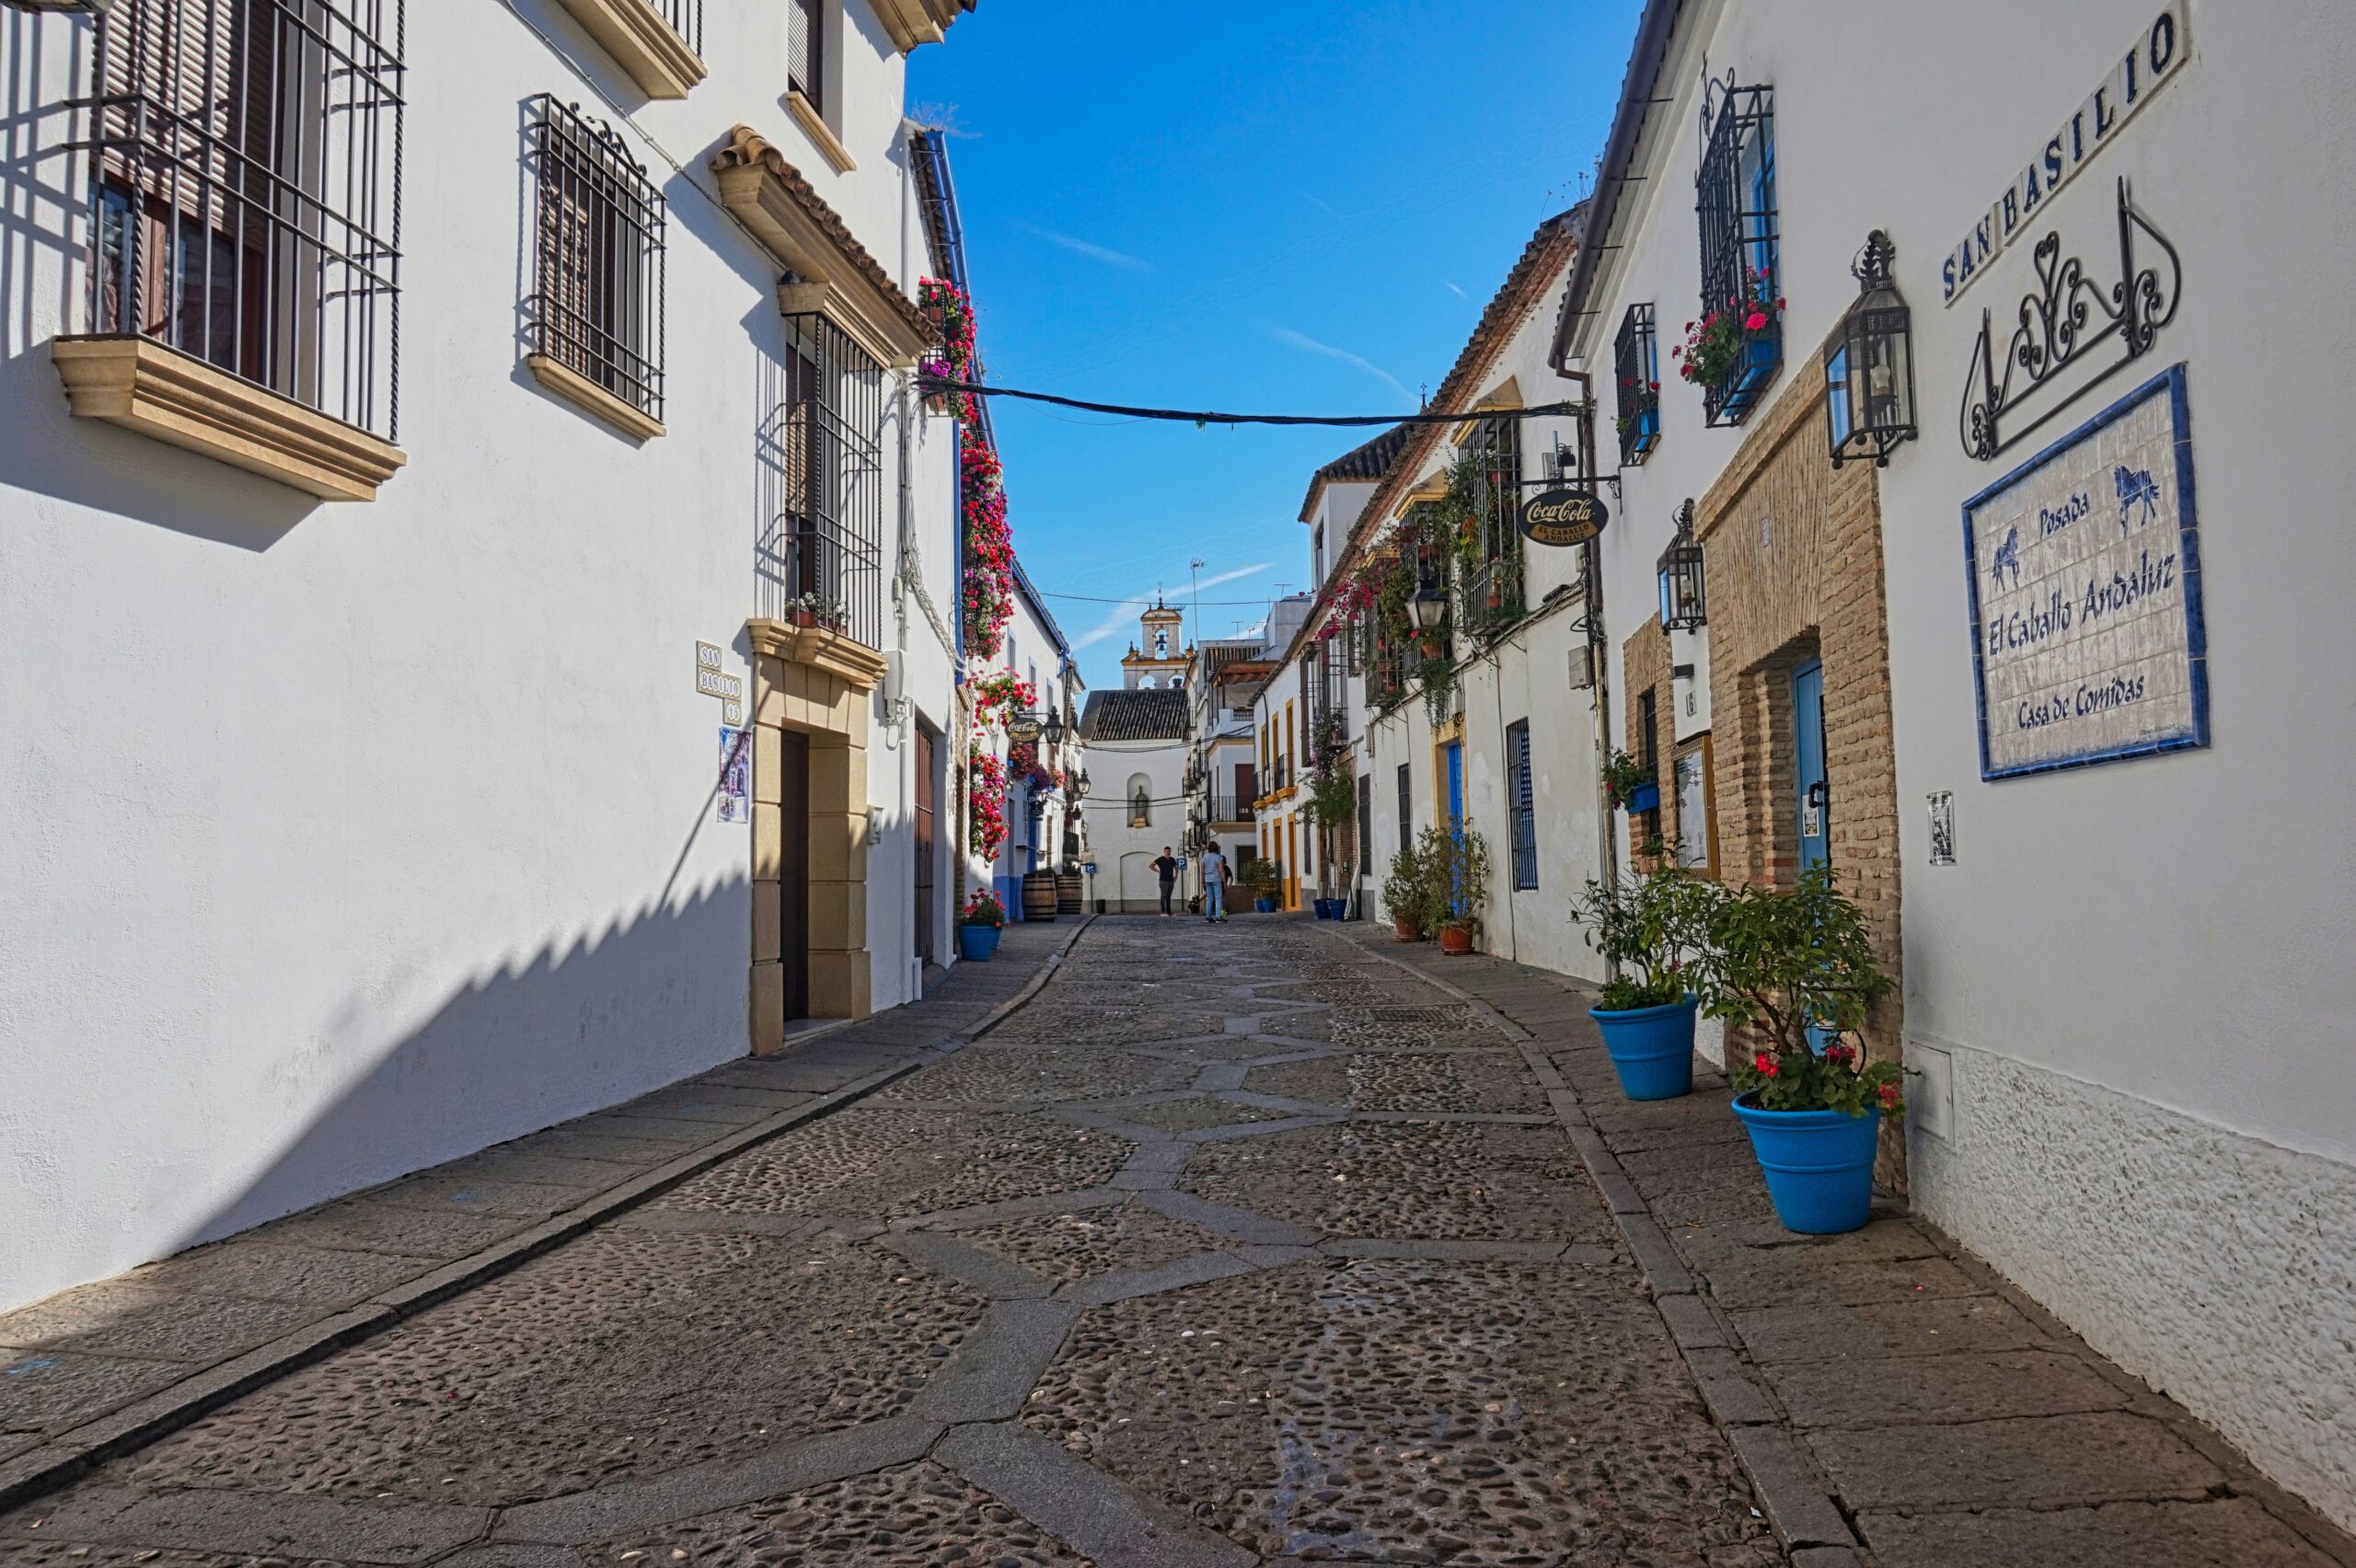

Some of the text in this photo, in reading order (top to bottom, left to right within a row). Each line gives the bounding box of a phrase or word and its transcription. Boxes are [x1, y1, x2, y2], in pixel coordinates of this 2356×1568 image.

[1943, 13, 2175, 301] SAN BASILIO
[1526, 498, 1594, 524] Coca-Cola
[2039, 491, 2090, 541] Posada
[1538, 524, 1589, 536] EL CABALLO
[1542, 533, 1586, 543] ANDALUZ
[1988, 548, 2177, 656] El Caballo Andaluz
[702, 648, 719, 664] SAN
[701, 673, 739, 694] BASILIO
[2018, 675, 2145, 730] Casa de Comidas
